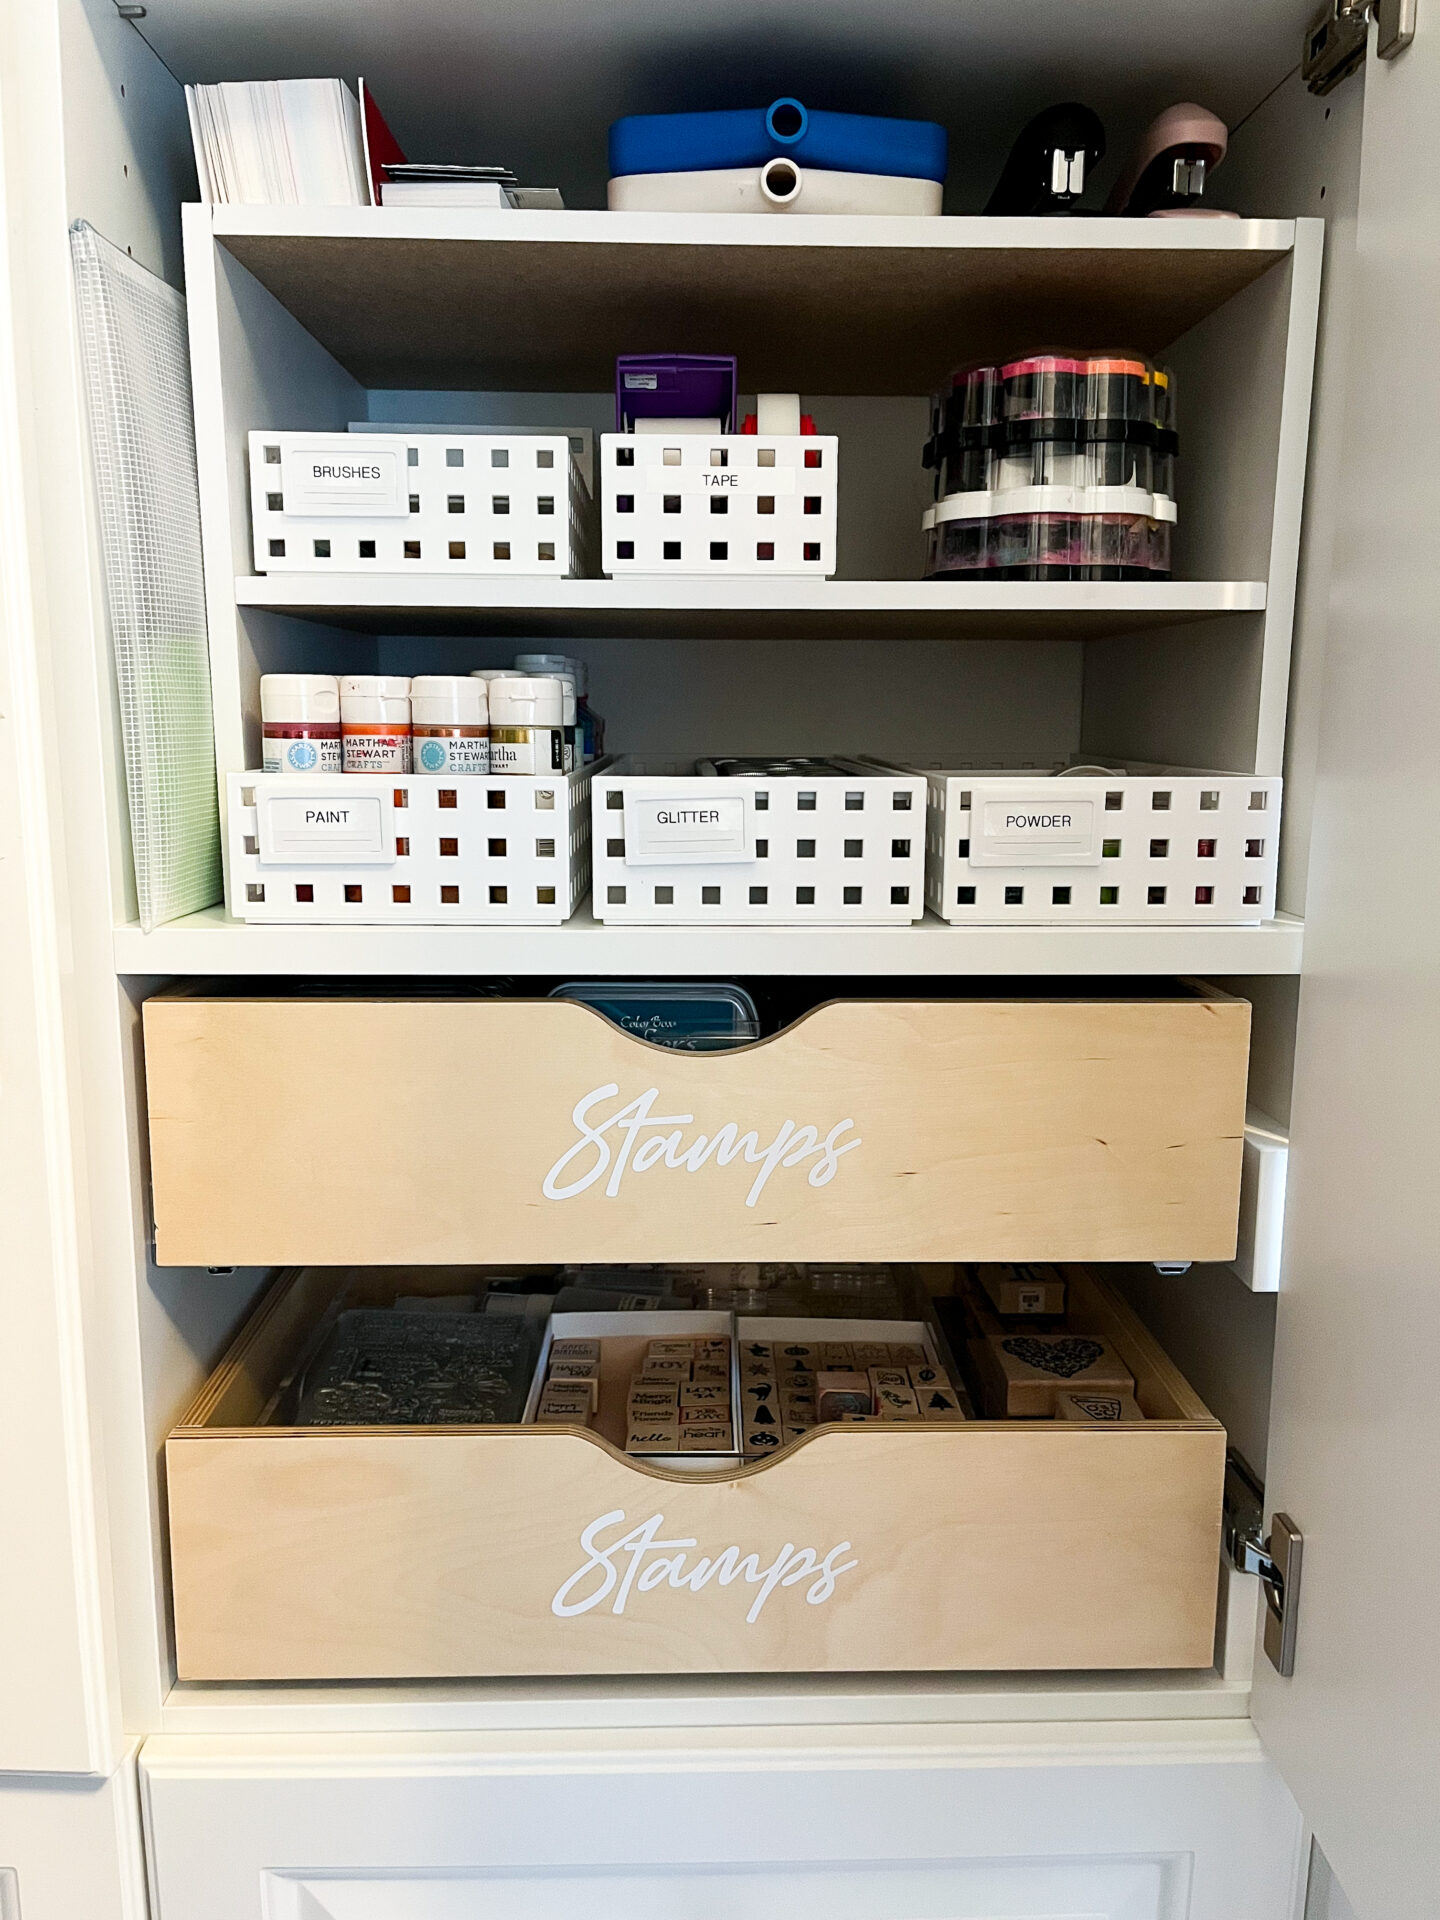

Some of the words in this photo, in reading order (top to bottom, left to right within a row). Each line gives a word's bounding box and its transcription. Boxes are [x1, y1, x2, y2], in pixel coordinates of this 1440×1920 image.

[313, 466, 381, 479] BRUSHES
[702, 474, 738, 486] TAPE
[345, 739, 389, 747] MARTHA
[449, 741, 488, 750] MARTHA
[346, 749, 396, 758] STEWART
[346, 760, 383, 769] CRAFTS
[449, 763, 487, 772] CRAFTS
[305, 810, 350, 823] PAINT
[657, 810, 719, 824] GLITTER
[1006, 815, 1072, 828] POWDER
[542, 1083, 862, 1208] Stamps
[647, 1361, 686, 1369] JOY
[630, 1433, 673, 1442] hello
[683, 1429, 726, 1439] heart
[551, 1509, 858, 1623] Stamps
